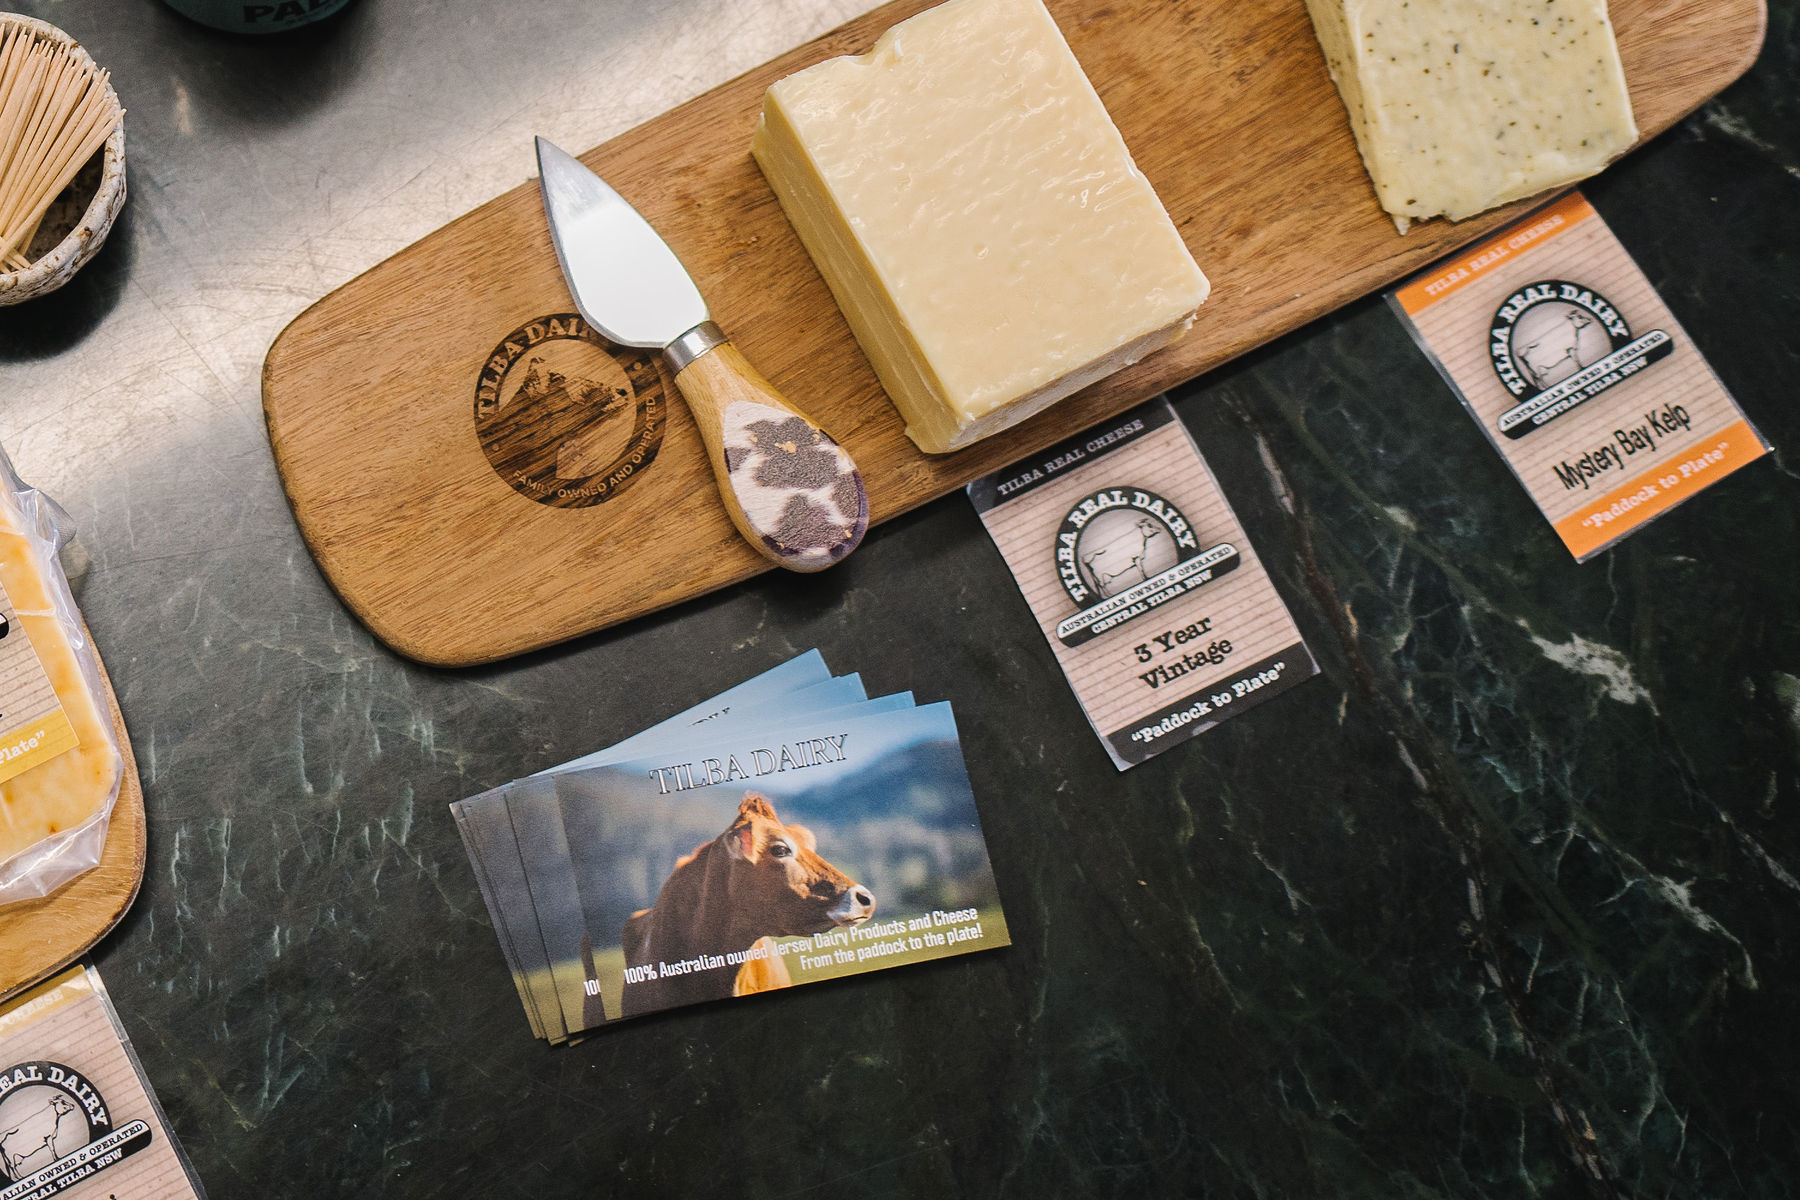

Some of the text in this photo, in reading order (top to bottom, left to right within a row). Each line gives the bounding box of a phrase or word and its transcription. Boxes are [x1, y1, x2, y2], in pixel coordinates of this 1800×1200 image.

[1425, 214, 1565, 296] TILBA REAL CHEESE
[1490, 282, 1629, 397] TILBA REAL DAIRY
[477, 340, 526, 419] TILBA
[1502, 383, 1567, 426] AUSTRALIAN
[1566, 366, 1601, 392] OWNED
[1613, 332, 1665, 365] OPERATED
[1531, 355, 1649, 425] CENTRAL TILBA NSW
[512, 396, 656, 499] FAMILY OWNED AND OPERATED
[997, 418, 1145, 496] TILBA REAL CHEESE
[1552, 401, 1691, 491] Mystery Bay Kelp
[1657, 469, 1680, 490] to
[1056, 489, 1198, 603] TILBA REAL DAIRY
[1061, 545, 1232, 635] AUSTRALIAN OWNED & OPERATED
[1090, 569, 1213, 635] CENTRAL TILBA NSW
[1133, 616, 1213, 664] 3 Year
[1138, 637, 1234, 690] Vintage
[1210, 689, 1232, 708] to
[649, 733, 849, 795] TILBA DAIRY
[624, 907, 979, 985] 100% Australian owned Jersey Dairy Products and Cheese
[800, 922, 984, 971] From the paddock to the plate!
[46, 1066, 109, 1128] DAIRY
[38, 1157, 77, 1183] OWNED
[78, 1152, 88, 1162] &
[88, 1122, 144, 1155] OPERATED
[56, 1163, 96, 1190] TILBA
[95, 1147, 123, 1169] NSW
